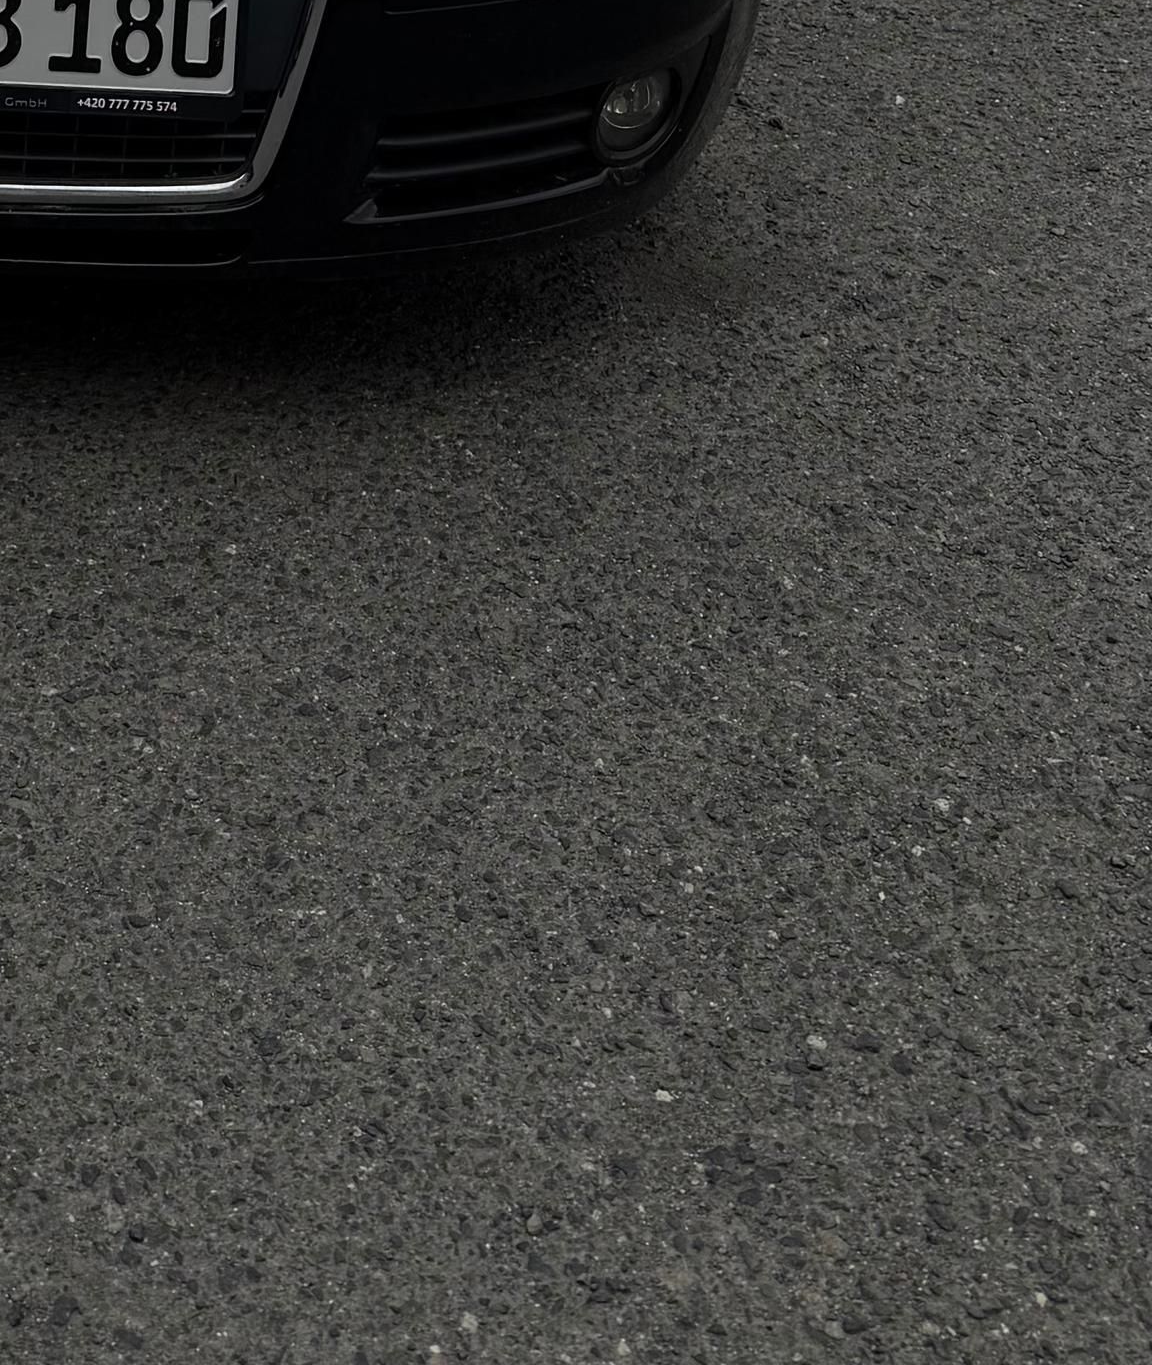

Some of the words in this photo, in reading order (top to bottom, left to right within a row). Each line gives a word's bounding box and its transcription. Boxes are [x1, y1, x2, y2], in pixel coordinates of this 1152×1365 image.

[4, 96, 48, 109] GmbH
[76, 97, 106, 109] +420
[108, 98, 130, 110] 777
[132, 100, 154, 111] 775
[156, 101, 177, 112] 574
